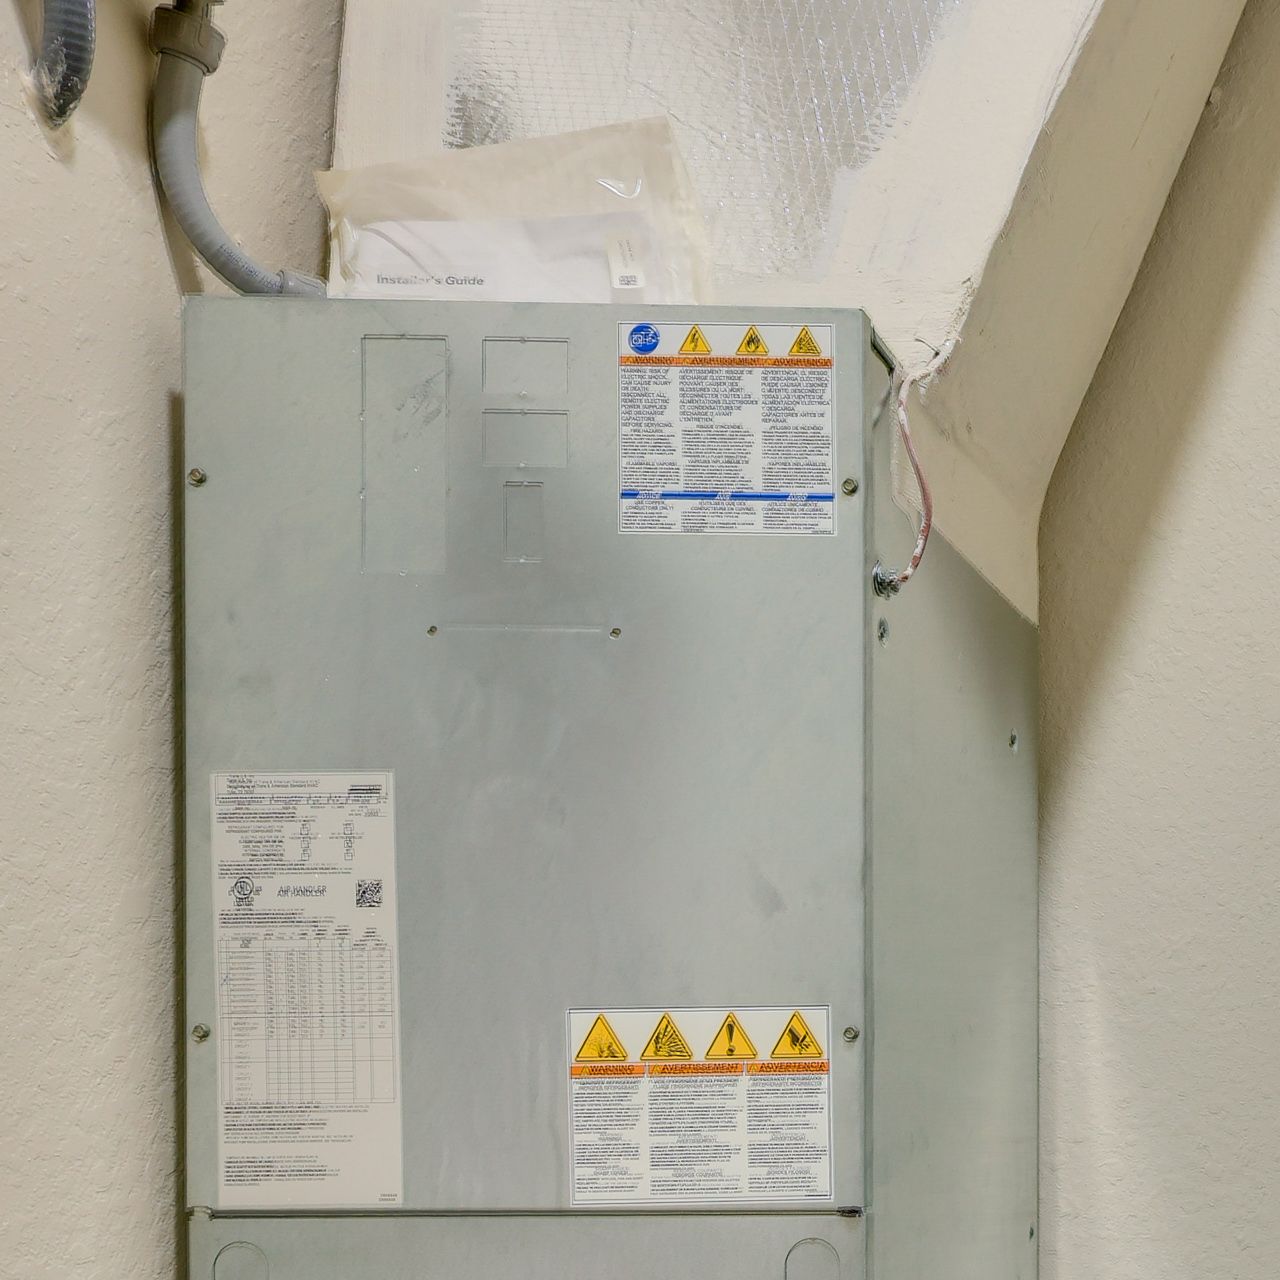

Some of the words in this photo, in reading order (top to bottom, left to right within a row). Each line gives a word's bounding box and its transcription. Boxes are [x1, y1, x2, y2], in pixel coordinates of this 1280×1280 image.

[376, 273, 441, 286] Installr's
[444, 275, 484, 286] Guide
[589, 1065, 635, 1076] WARNING
[661, 1063, 739, 1075] AVERTISSEMENT
[758, 1061, 827, 1073] ADVERTENCIA
